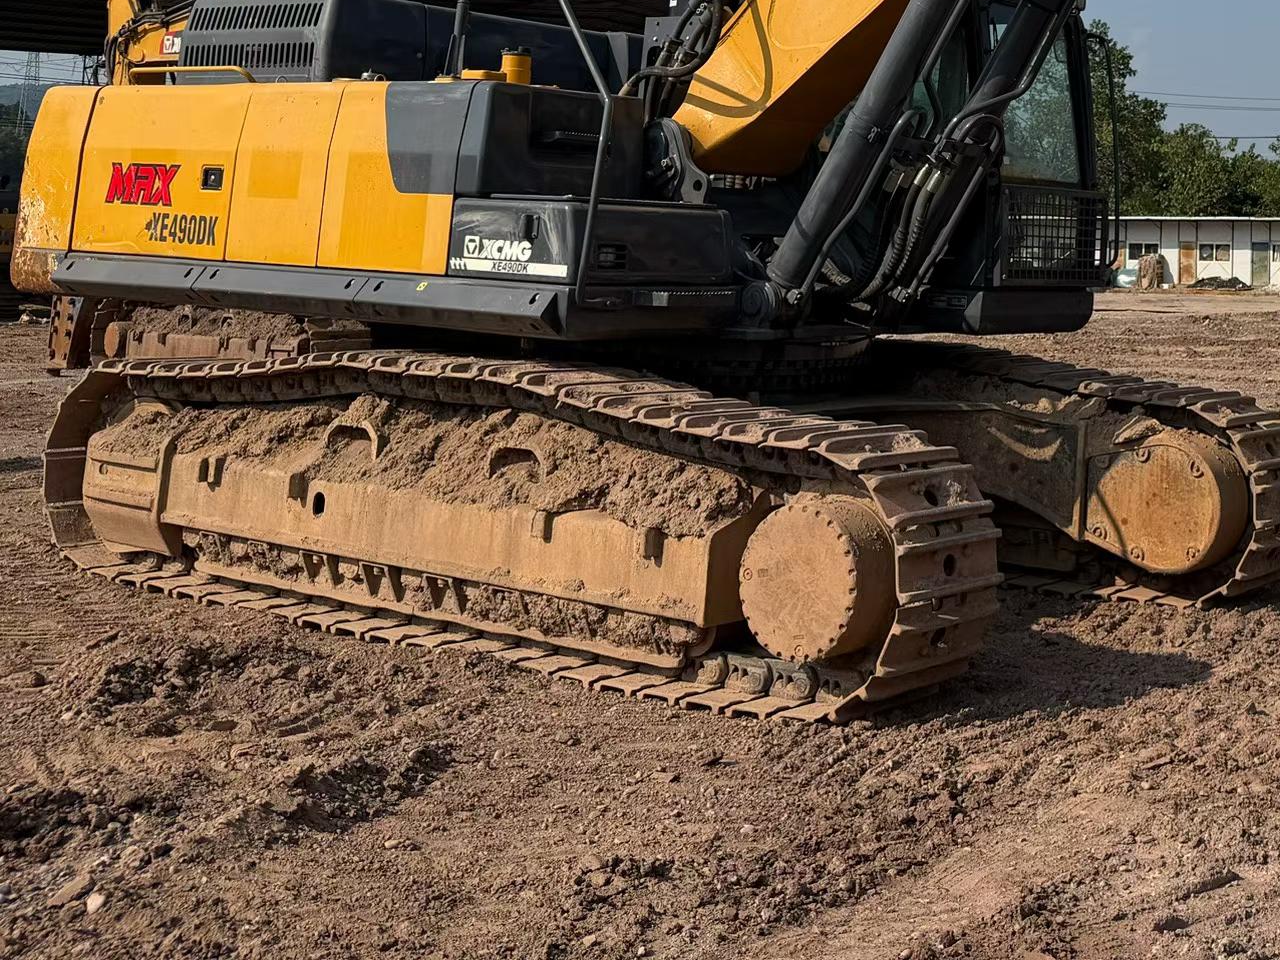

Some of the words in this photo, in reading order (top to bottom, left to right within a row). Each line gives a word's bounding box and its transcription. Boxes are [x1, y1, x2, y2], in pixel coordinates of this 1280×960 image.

[105, 162, 181, 207] MAX
[148, 212, 218, 246] XE490DK
[480, 239, 532, 261] XCMG
[491, 261, 529, 273] XE490DK
